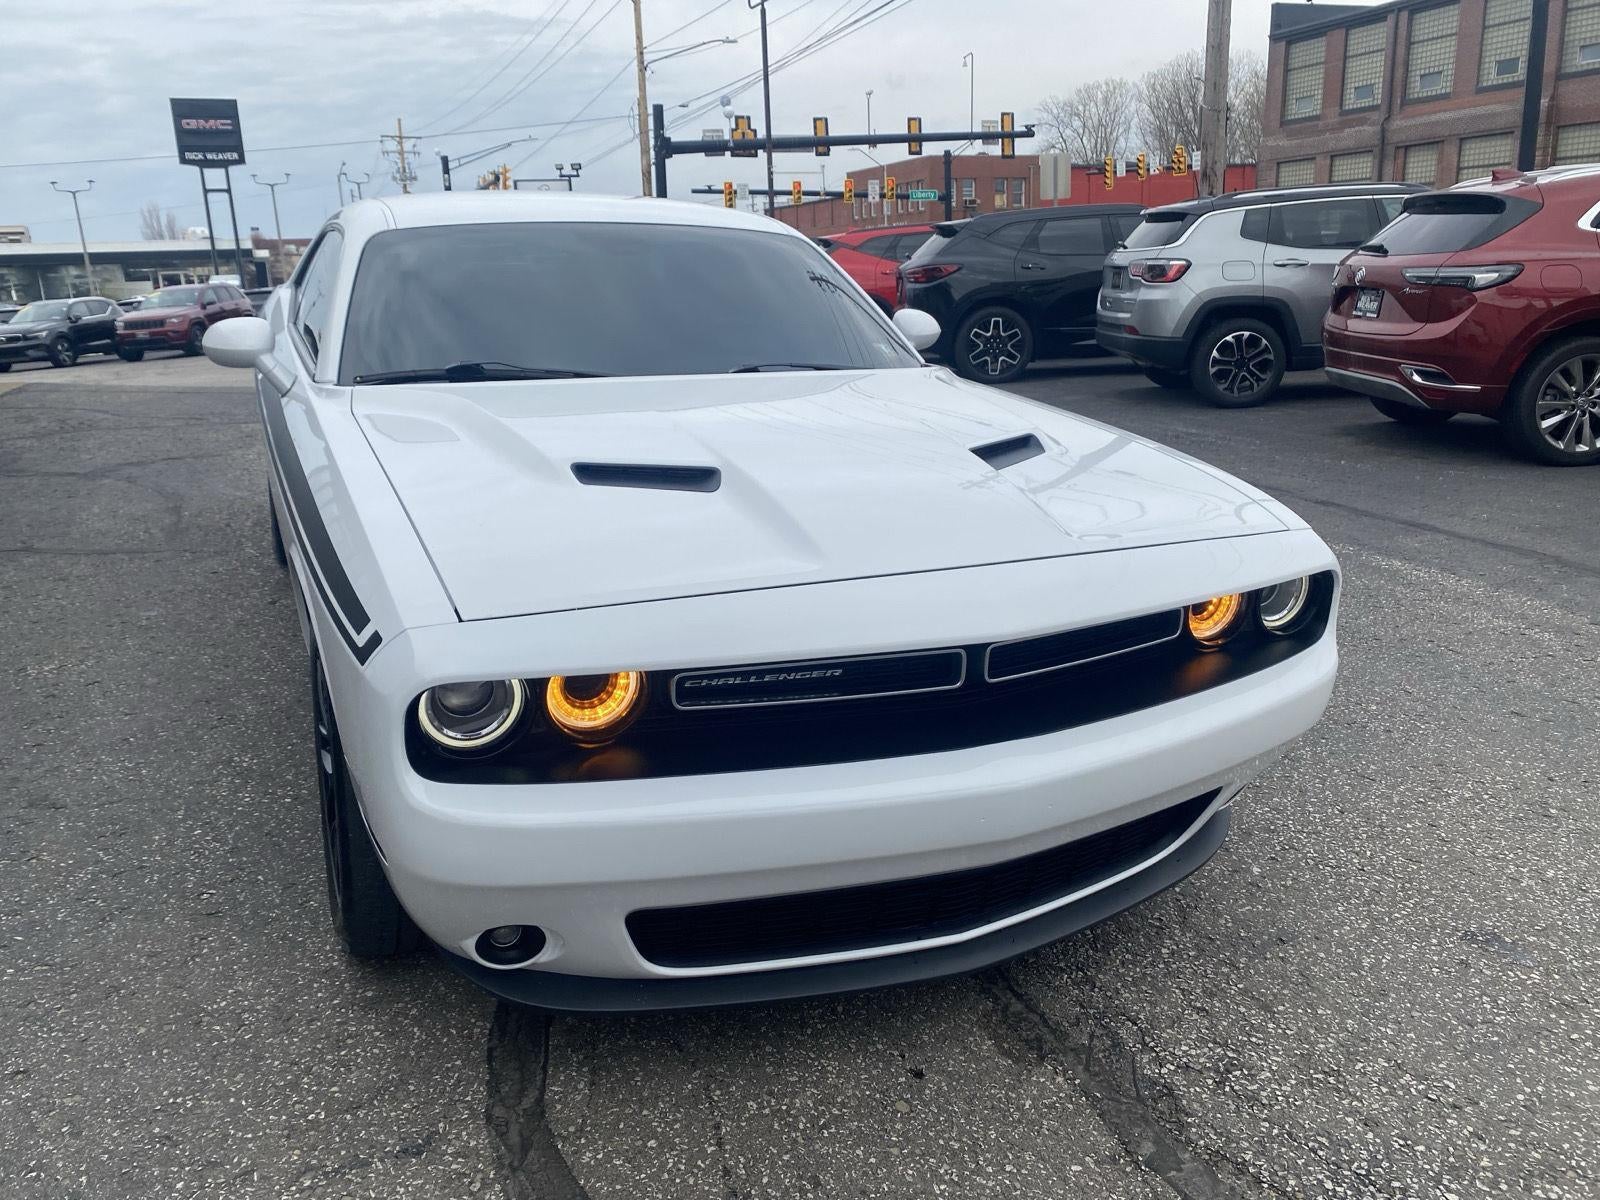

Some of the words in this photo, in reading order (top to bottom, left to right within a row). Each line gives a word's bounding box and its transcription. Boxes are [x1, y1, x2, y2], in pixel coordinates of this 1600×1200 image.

[181, 119, 233, 129] GMC
[184, 152, 204, 160] RICK
[205, 152, 239, 160] WEAVER
[911, 191, 936, 199] Liberty
[684, 669, 843, 687] CHALLENGER
